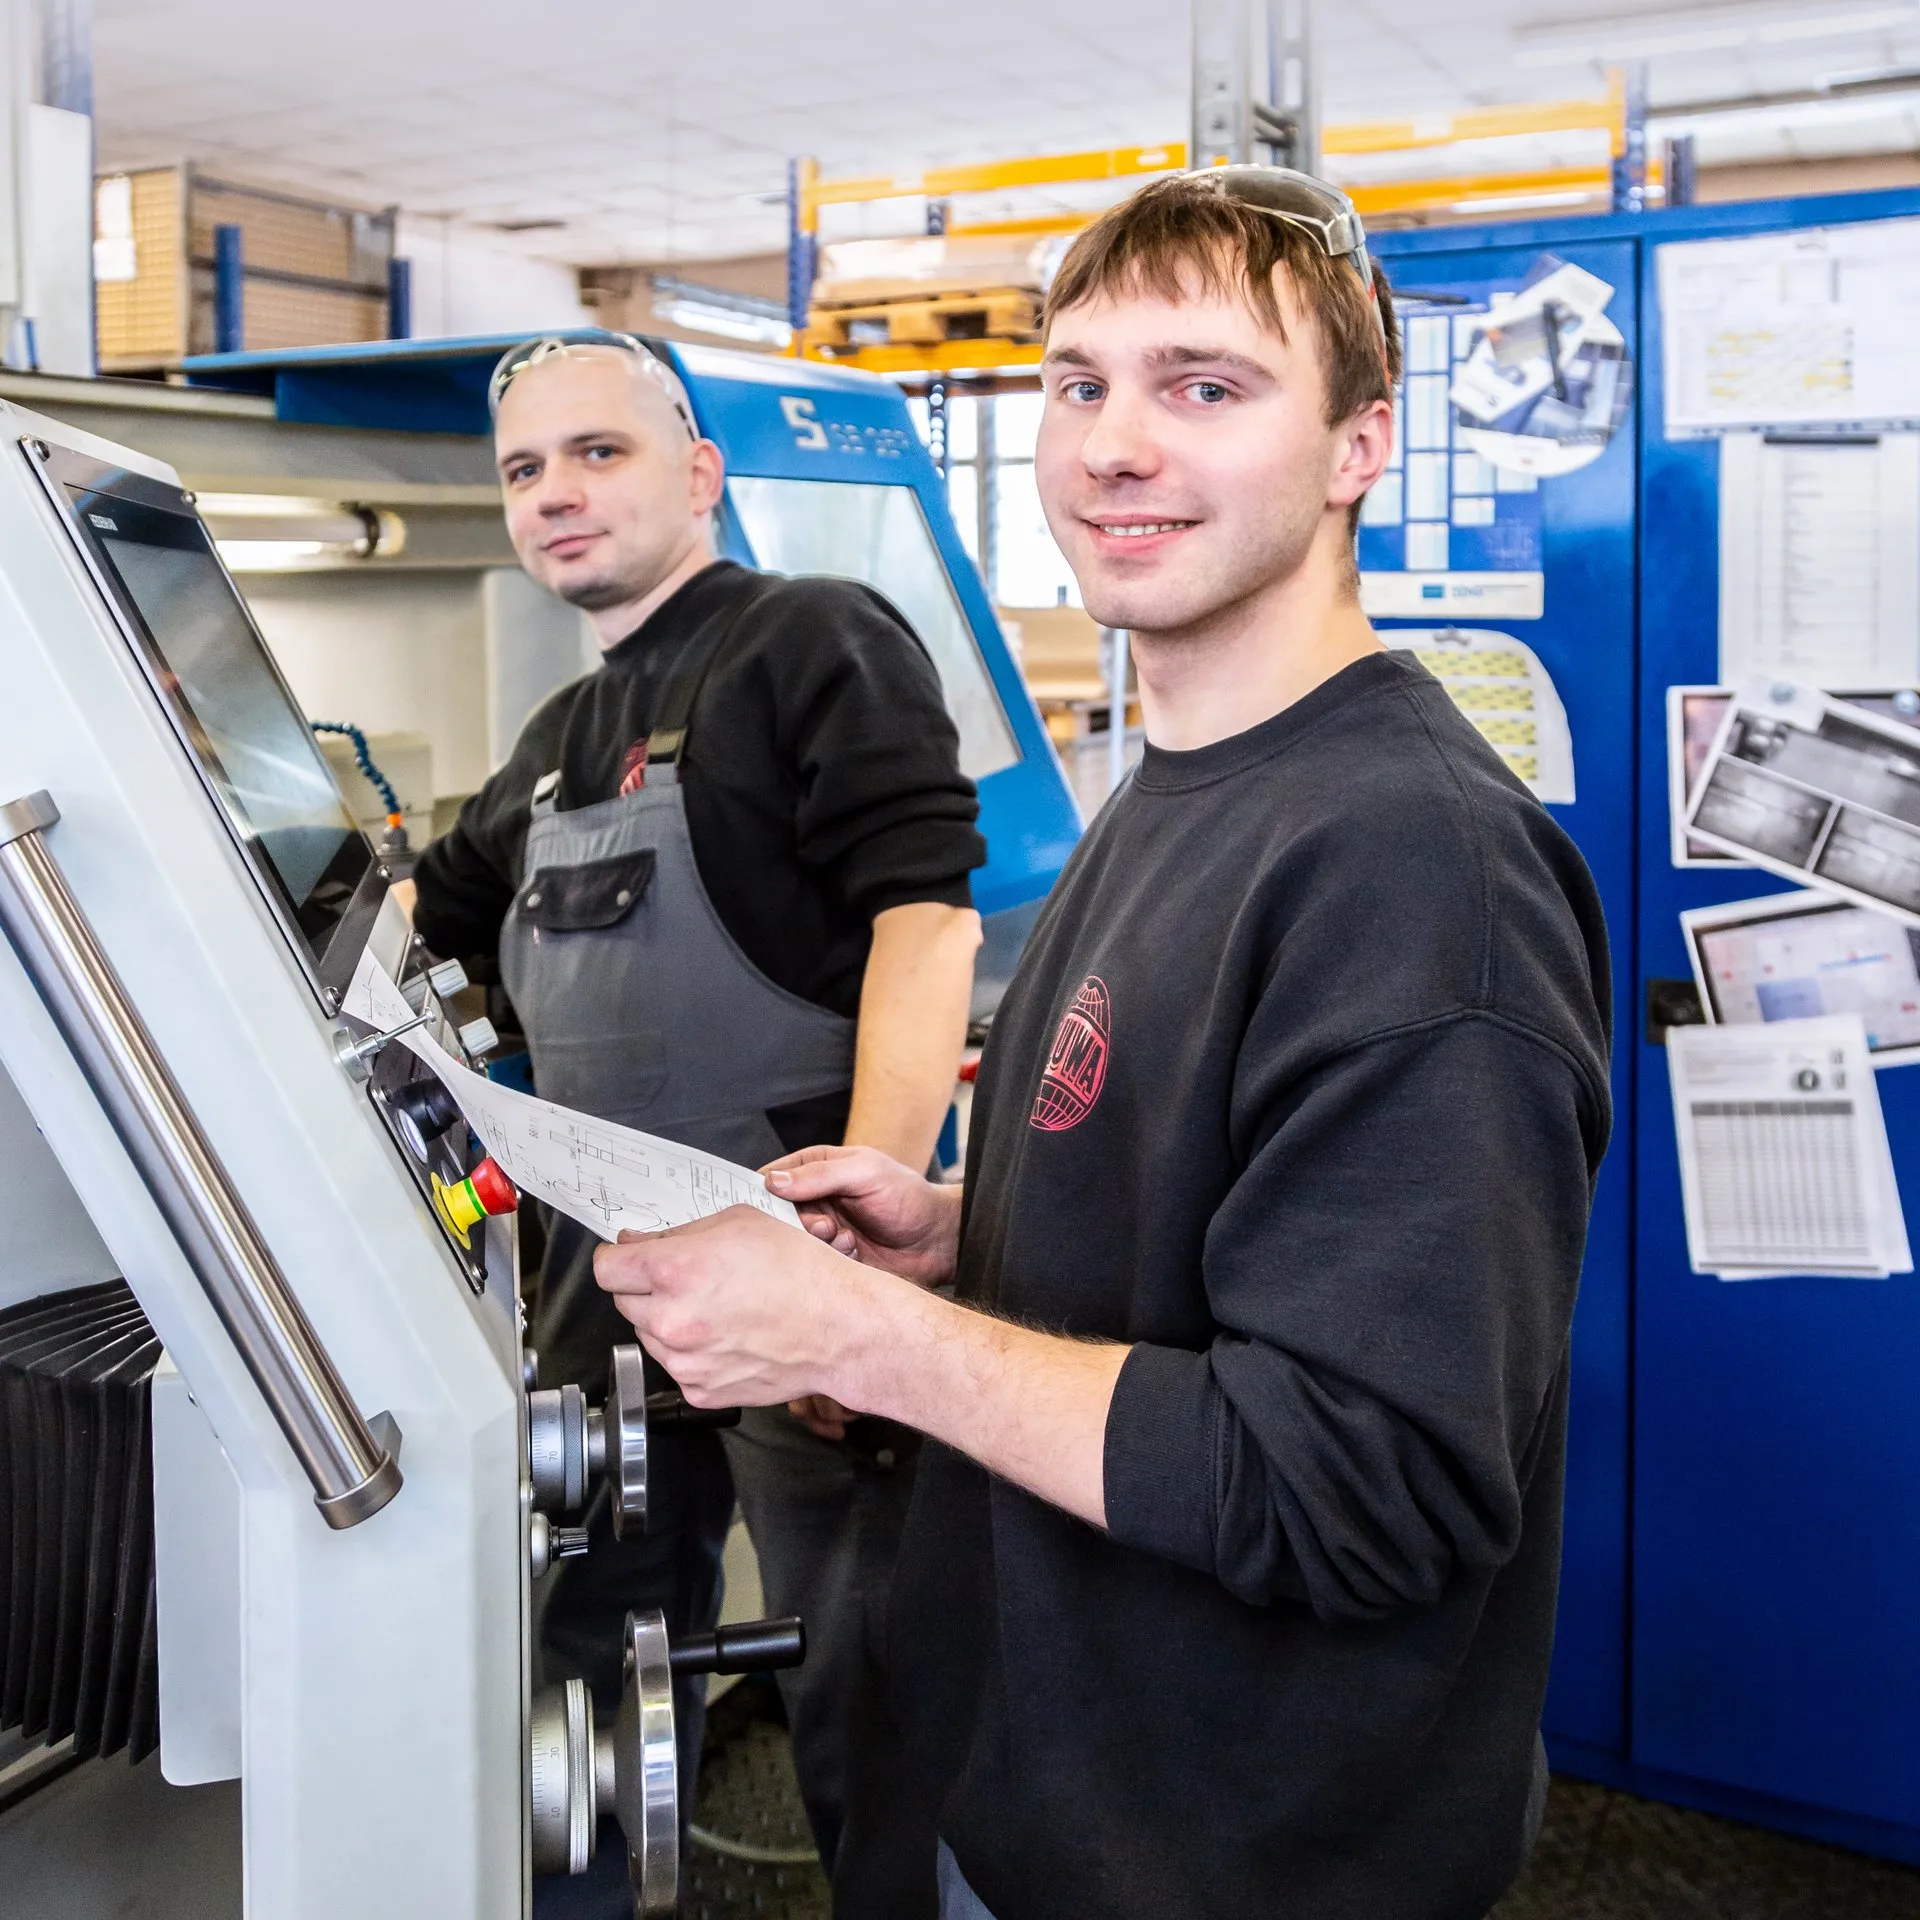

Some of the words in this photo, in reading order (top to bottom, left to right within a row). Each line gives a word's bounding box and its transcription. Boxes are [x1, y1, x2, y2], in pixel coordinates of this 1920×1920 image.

[1048, 1018, 1103, 1098] UWA
[549, 1450, 558, 1461] 70
[551, 1747, 559, 1758] 30
[551, 1807, 560, 1818] 40
